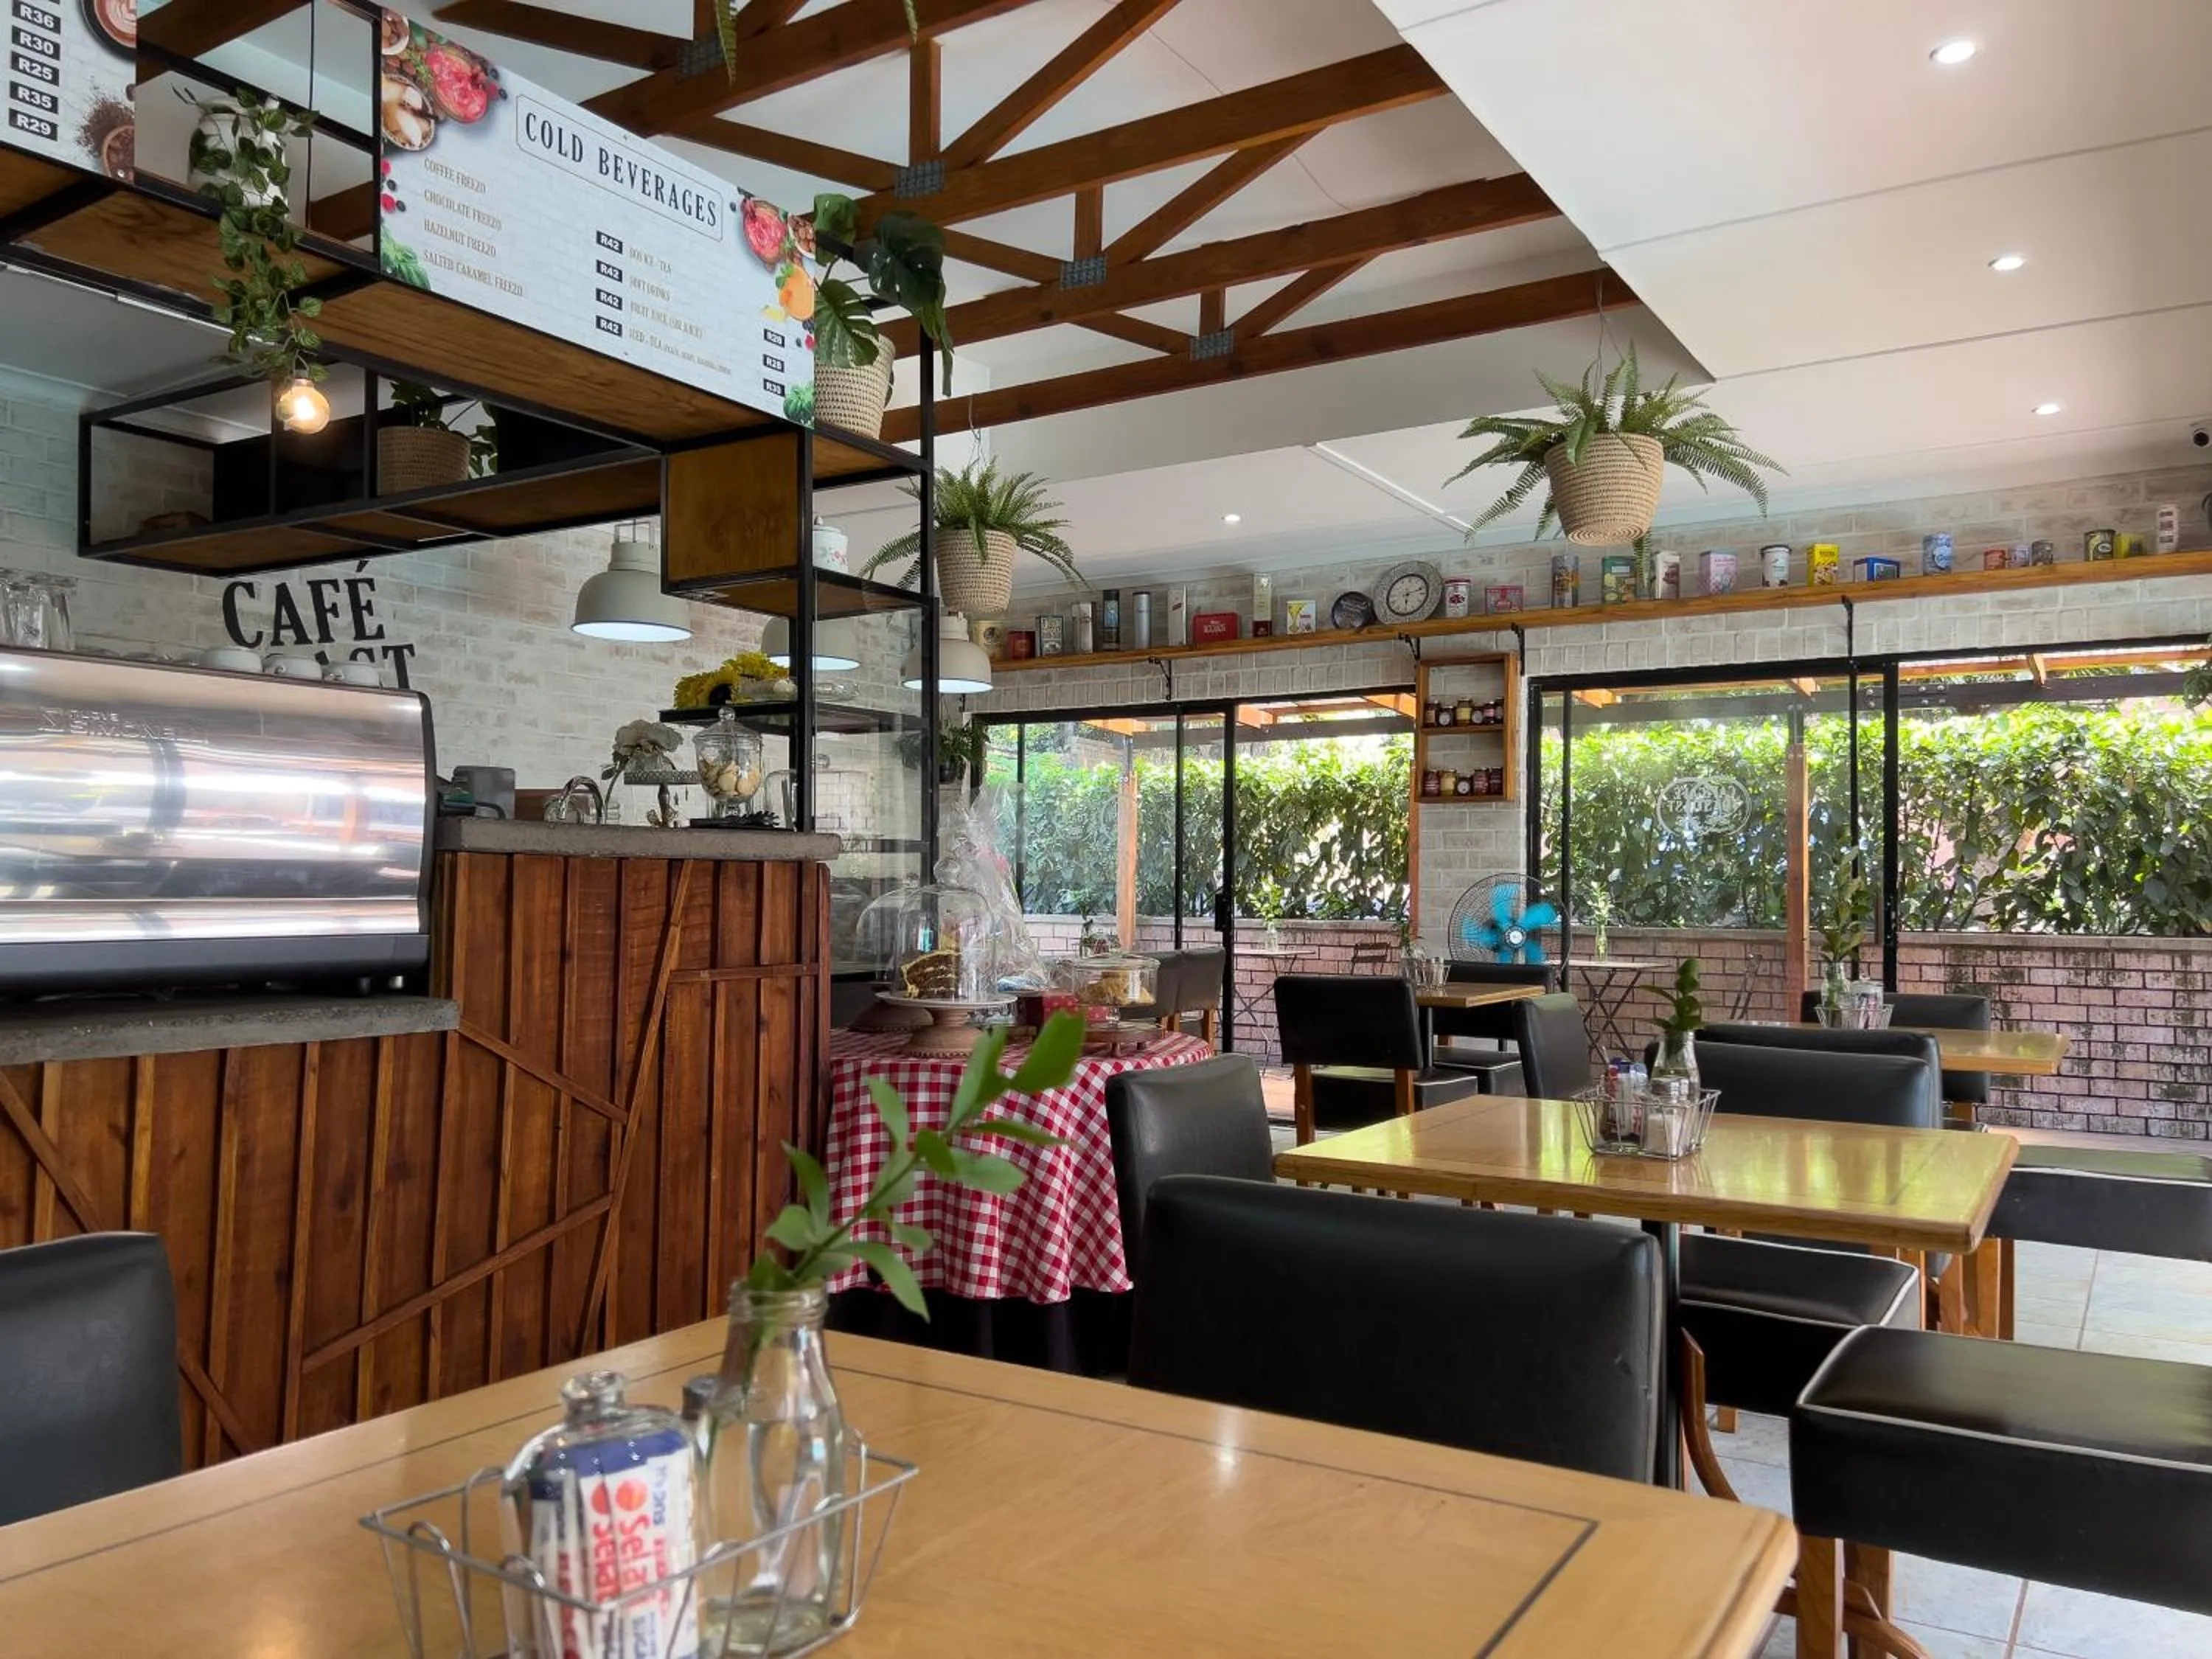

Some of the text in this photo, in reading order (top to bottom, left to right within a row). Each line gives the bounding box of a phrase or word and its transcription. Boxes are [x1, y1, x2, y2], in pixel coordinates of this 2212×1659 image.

[20, 4, 54, 29] R36
[19, 31, 54, 55] R30
[18, 58, 53, 80] R25
[17, 84, 52, 109] R35
[16, 113, 52, 136] R29
[424, 156, 487, 195] COFFEE FREEZO
[525, 111, 717, 227] COLD BEVERAGES
[424, 188, 470, 219] CHOCOLATE
[424, 218, 497, 257] HAZELNUT FREEZO
[600, 234, 620, 251] R42
[423, 248, 524, 296] SALTED CARAMEL FREEZO
[600, 263, 620, 279] R42
[599, 291, 619, 307] R42
[599, 319, 619, 334] R42
[223, 560, 385, 648] CAFÉ
